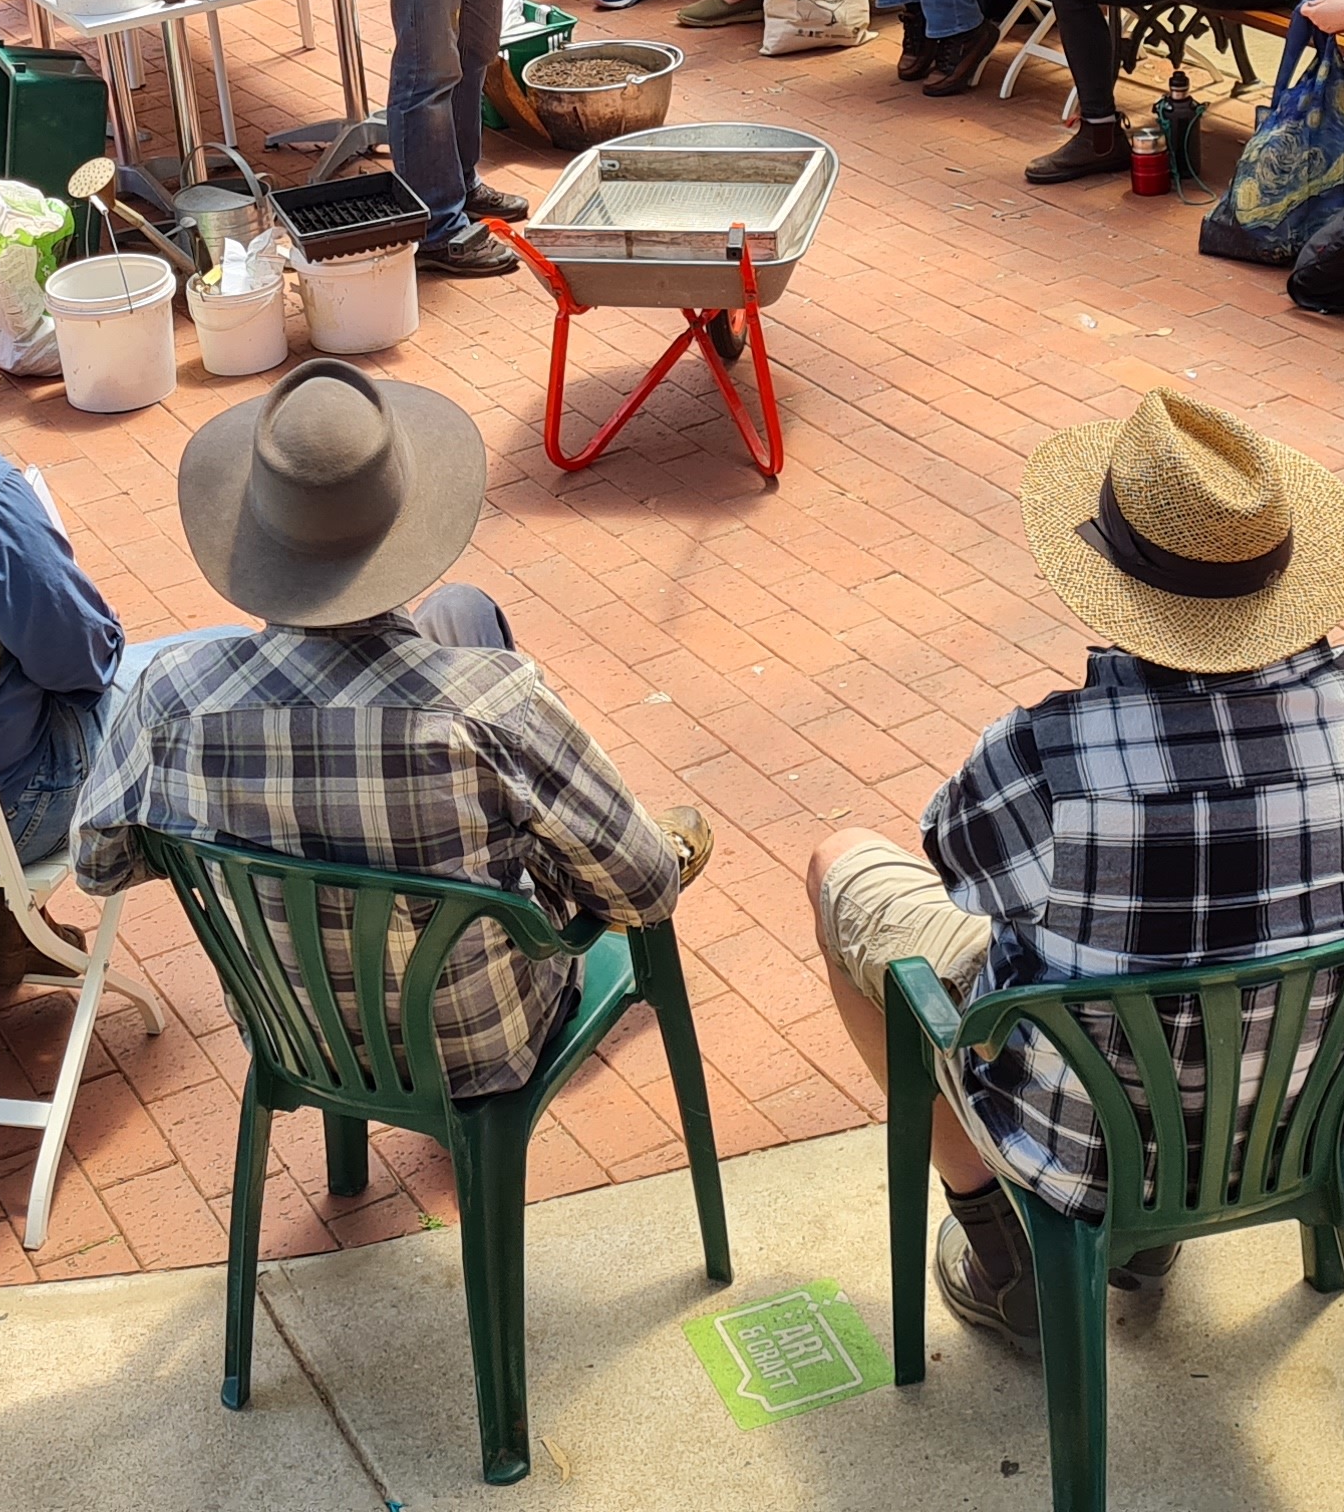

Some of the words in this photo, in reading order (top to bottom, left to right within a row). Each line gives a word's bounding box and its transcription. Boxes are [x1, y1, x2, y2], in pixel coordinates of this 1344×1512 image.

[738, 1325, 766, 1340] &
[772, 1323, 833, 1370] ART
[745, 1338, 799, 1389] CRAFT
